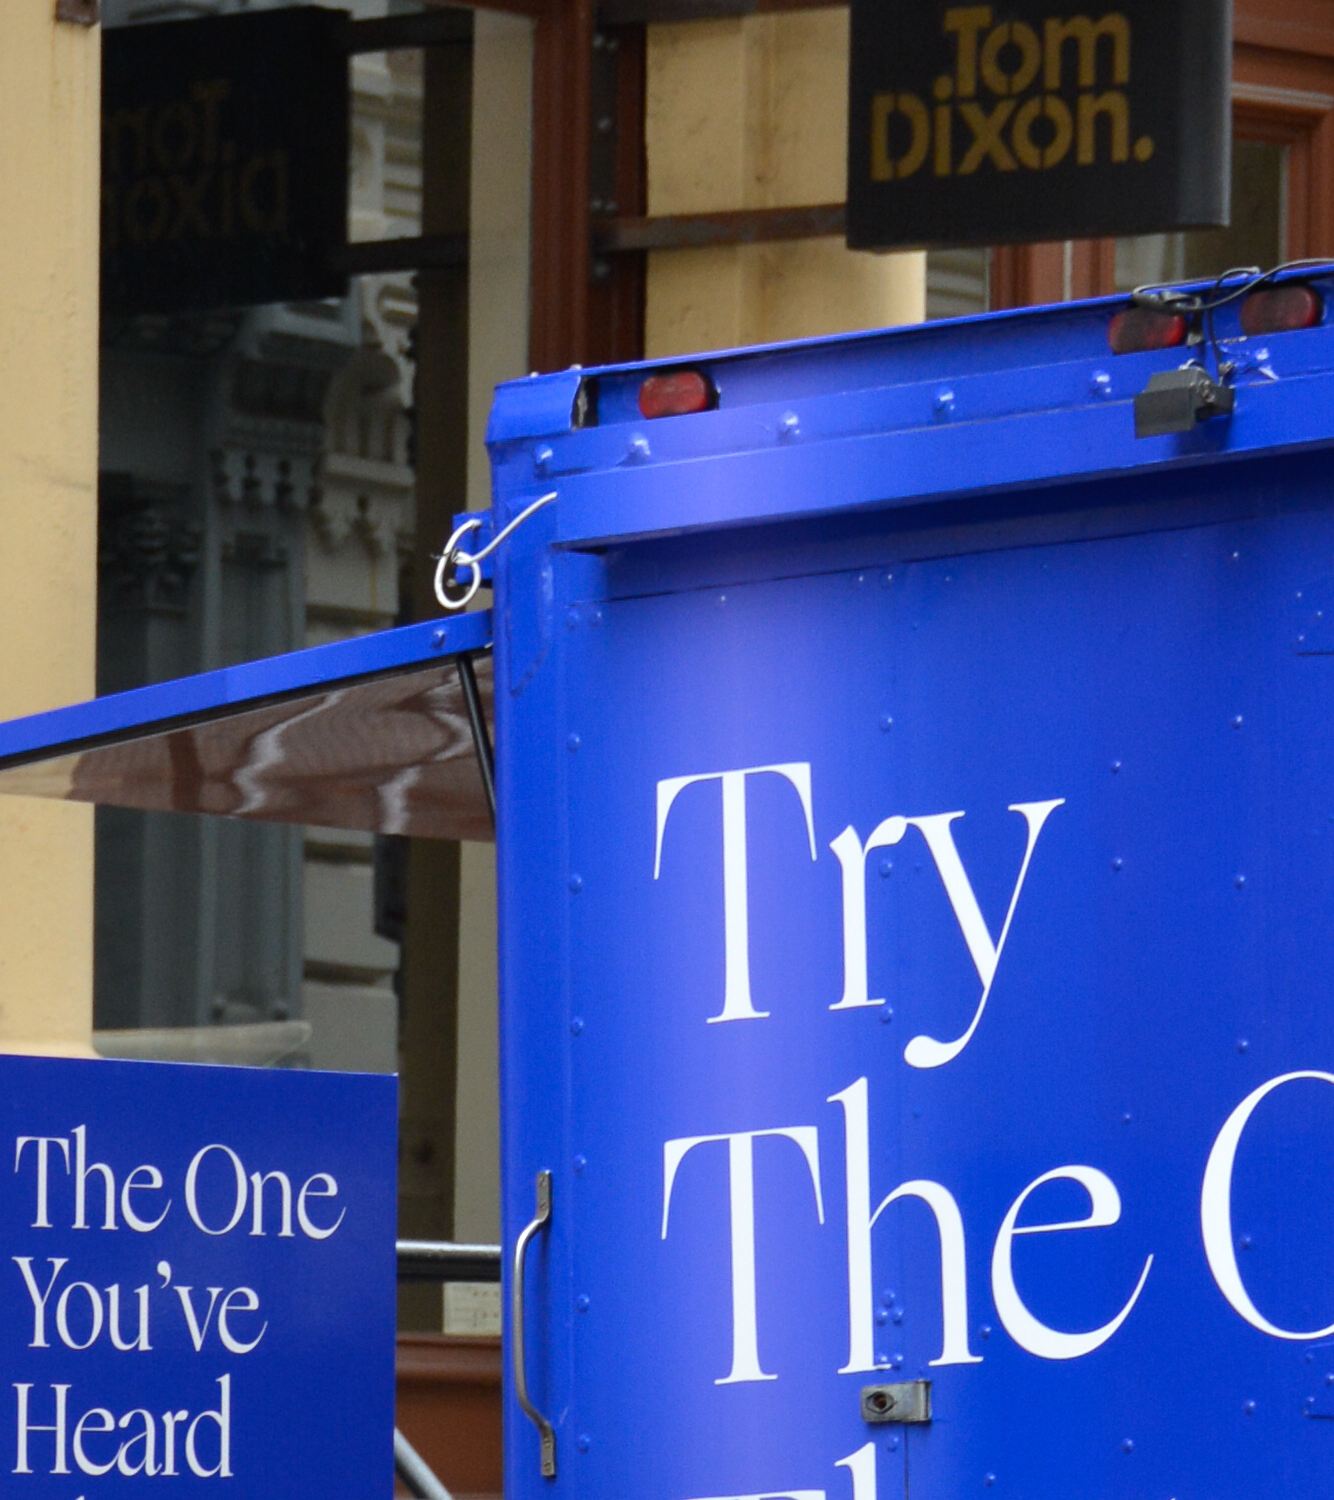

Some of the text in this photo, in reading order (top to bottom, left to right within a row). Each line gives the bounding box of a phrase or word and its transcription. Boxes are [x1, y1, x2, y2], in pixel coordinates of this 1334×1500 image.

[942, 4, 1131, 99] Tom
[870, 75, 1156, 183] Dixon.
[654, 762, 1065, 1069] Try
[14, 1124, 346, 1240] The One
[661, 1076, 1153, 1385] The
[11, 1256, 268, 1354] You've
[11, 1373, 234, 1478] Heard
